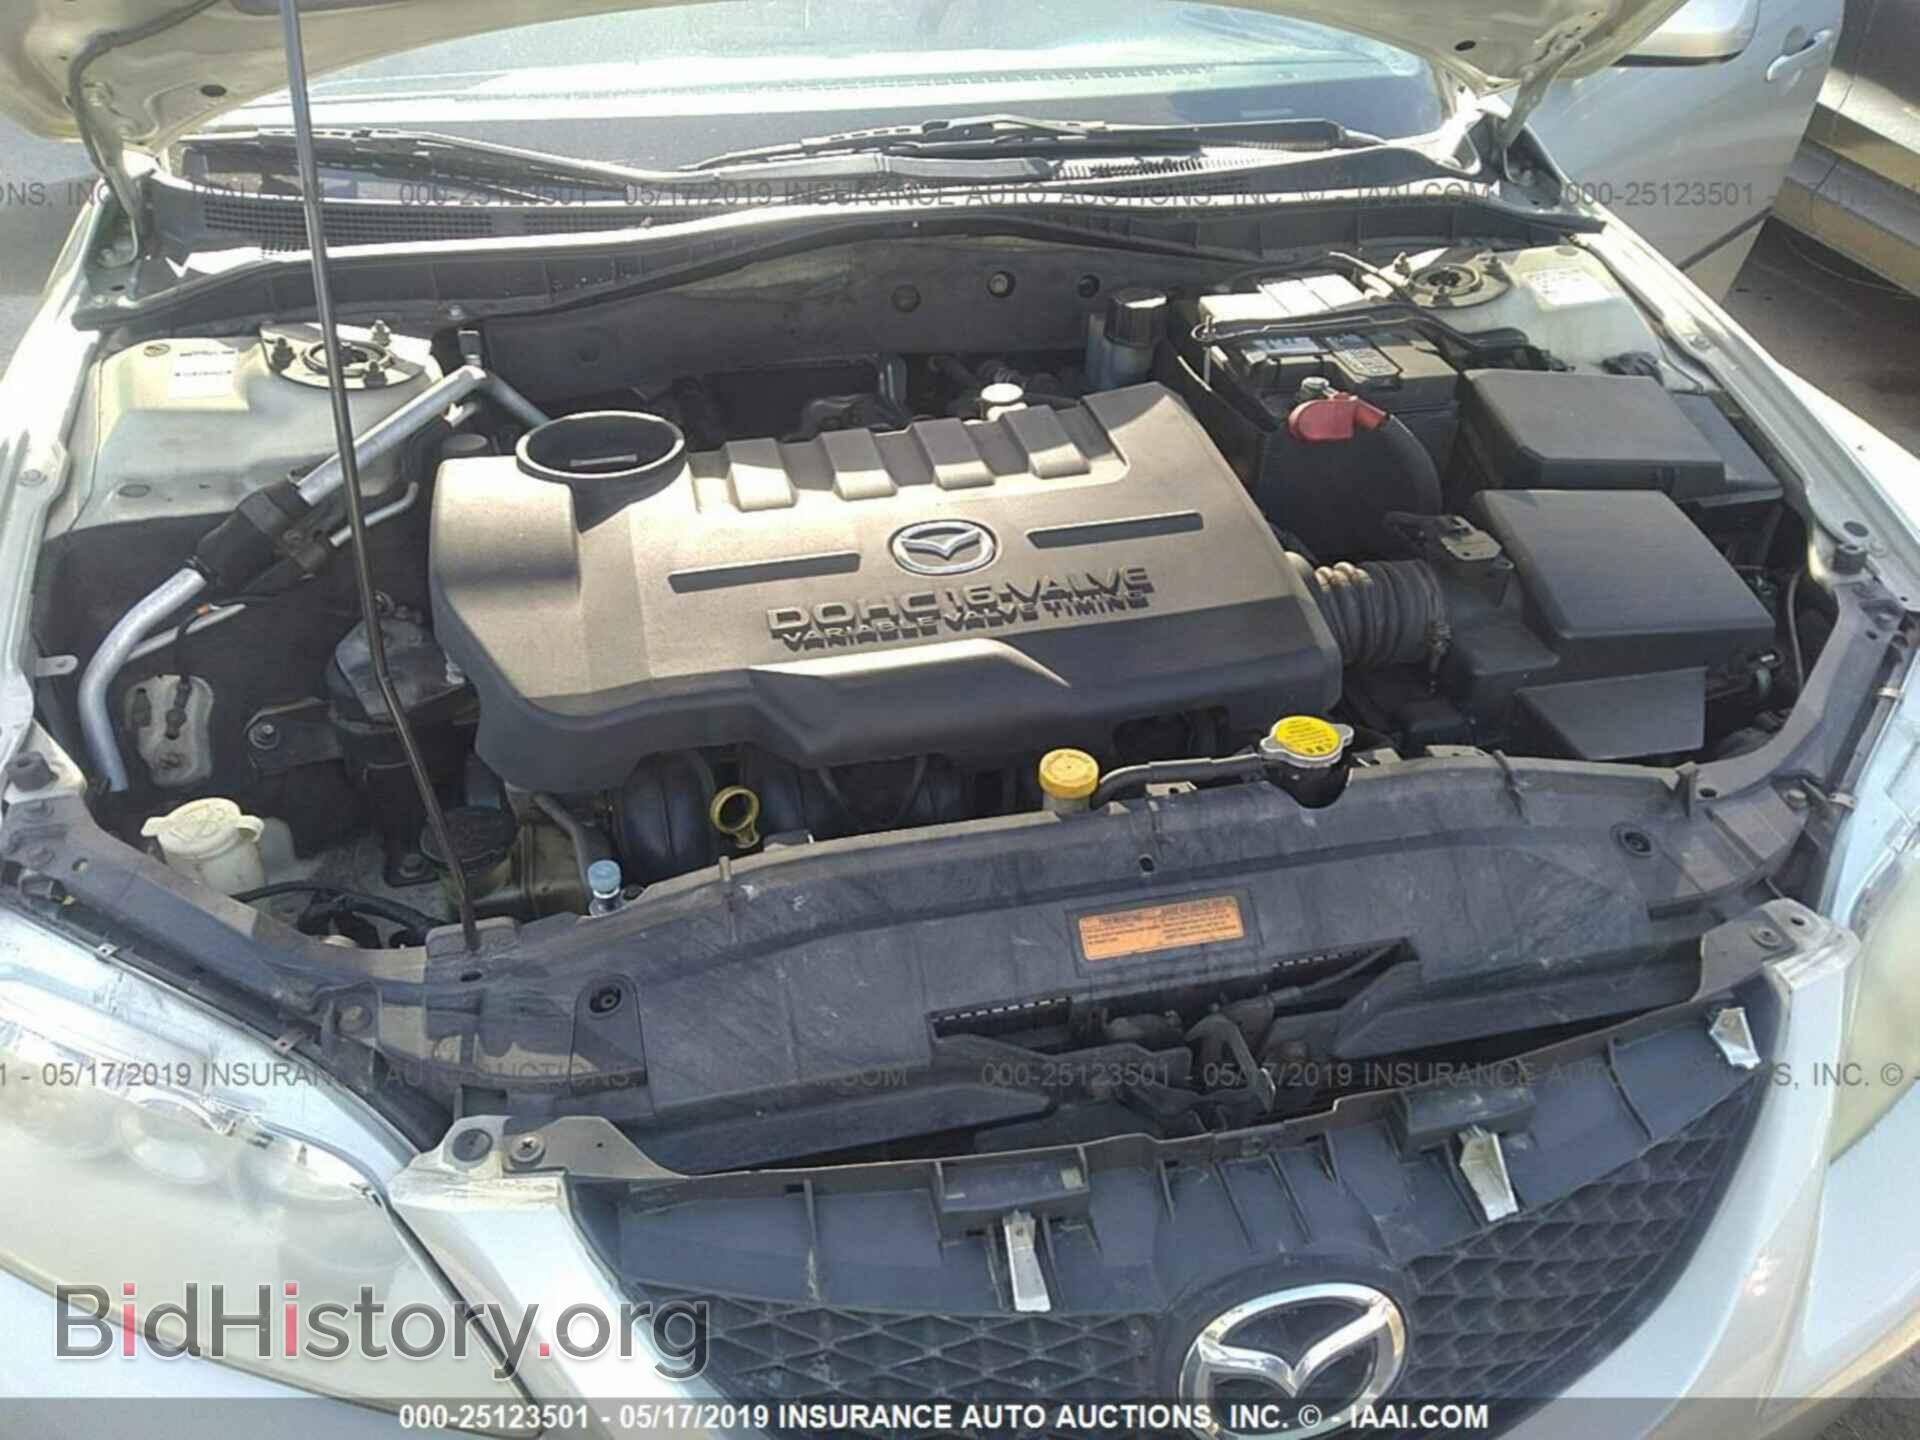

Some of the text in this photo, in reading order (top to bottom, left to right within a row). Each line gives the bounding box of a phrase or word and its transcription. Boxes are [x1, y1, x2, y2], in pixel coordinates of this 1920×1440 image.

[768, 592, 939, 634] DOHC
[783, 589, 1150, 649] VARIABLE VALVE TIMING
